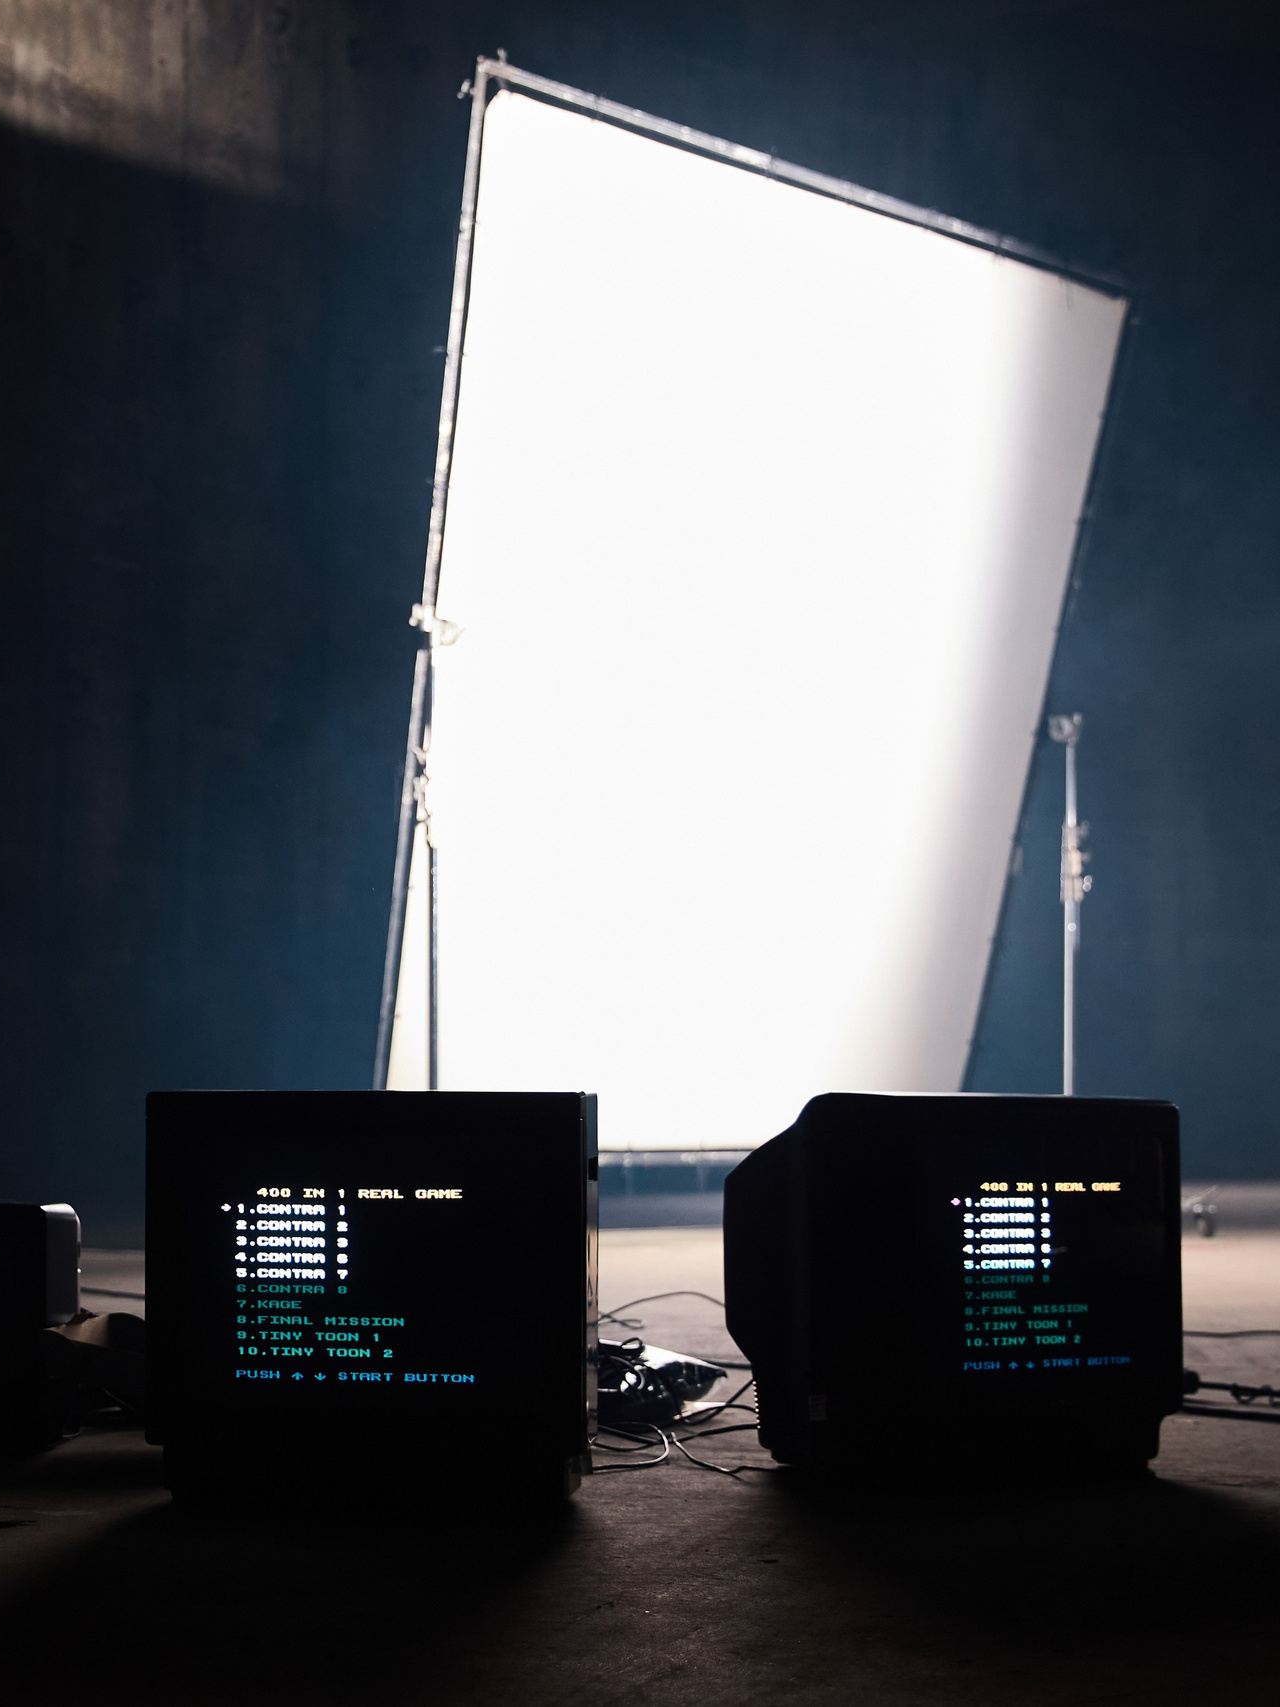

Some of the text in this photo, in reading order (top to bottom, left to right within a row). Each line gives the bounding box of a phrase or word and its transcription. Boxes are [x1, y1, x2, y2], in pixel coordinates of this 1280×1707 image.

[980, 1182, 1120, 1191] 400 IN 1 REAL GAME
[257, 1188, 462, 1199] 400 IN 1 REAL GAME
[965, 1197, 1049, 1208] 1.CONTRA 1
[238, 1204, 345, 1215] 1.CONTRA 1
[964, 1213, 1050, 1223] 2.CONTRA 2
[236, 1220, 348, 1232] 2.CONTRA 2
[964, 1228, 1051, 1239] 3.CONTRA 3
[236, 1236, 348, 1248] 3.CONTRA 3
[963, 1244, 1035, 1254] 4.CONTRA
[235, 1252, 348, 1264] 4.CONTRA 6
[964, 1259, 1051, 1269] 5.CONTRA 7
[236, 1268, 348, 1280] 5.CONTRA 7
[237, 1284, 347, 1294] 6.CONTRA 8
[965, 1290, 1016, 1299] 7.KAGE
[237, 1300, 301, 1309] 7.KAGE
[965, 1304, 1088, 1315] 8.FINAL MISSION
[237, 1316, 404, 1326] 8.FINAL MISSION
[965, 1320, 1071, 1331] 9.TINY TOON 1
[237, 1331, 378, 1342] 9.TINY TOON 1
[967, 1335, 1080, 1346] 10.TINY TOON 2
[239, 1347, 393, 1358] 10.TINY TOON 2
[964, 1356, 1130, 1370] PUSH START BUTTON
[236, 1370, 474, 1383] PUSH START BUTTON
